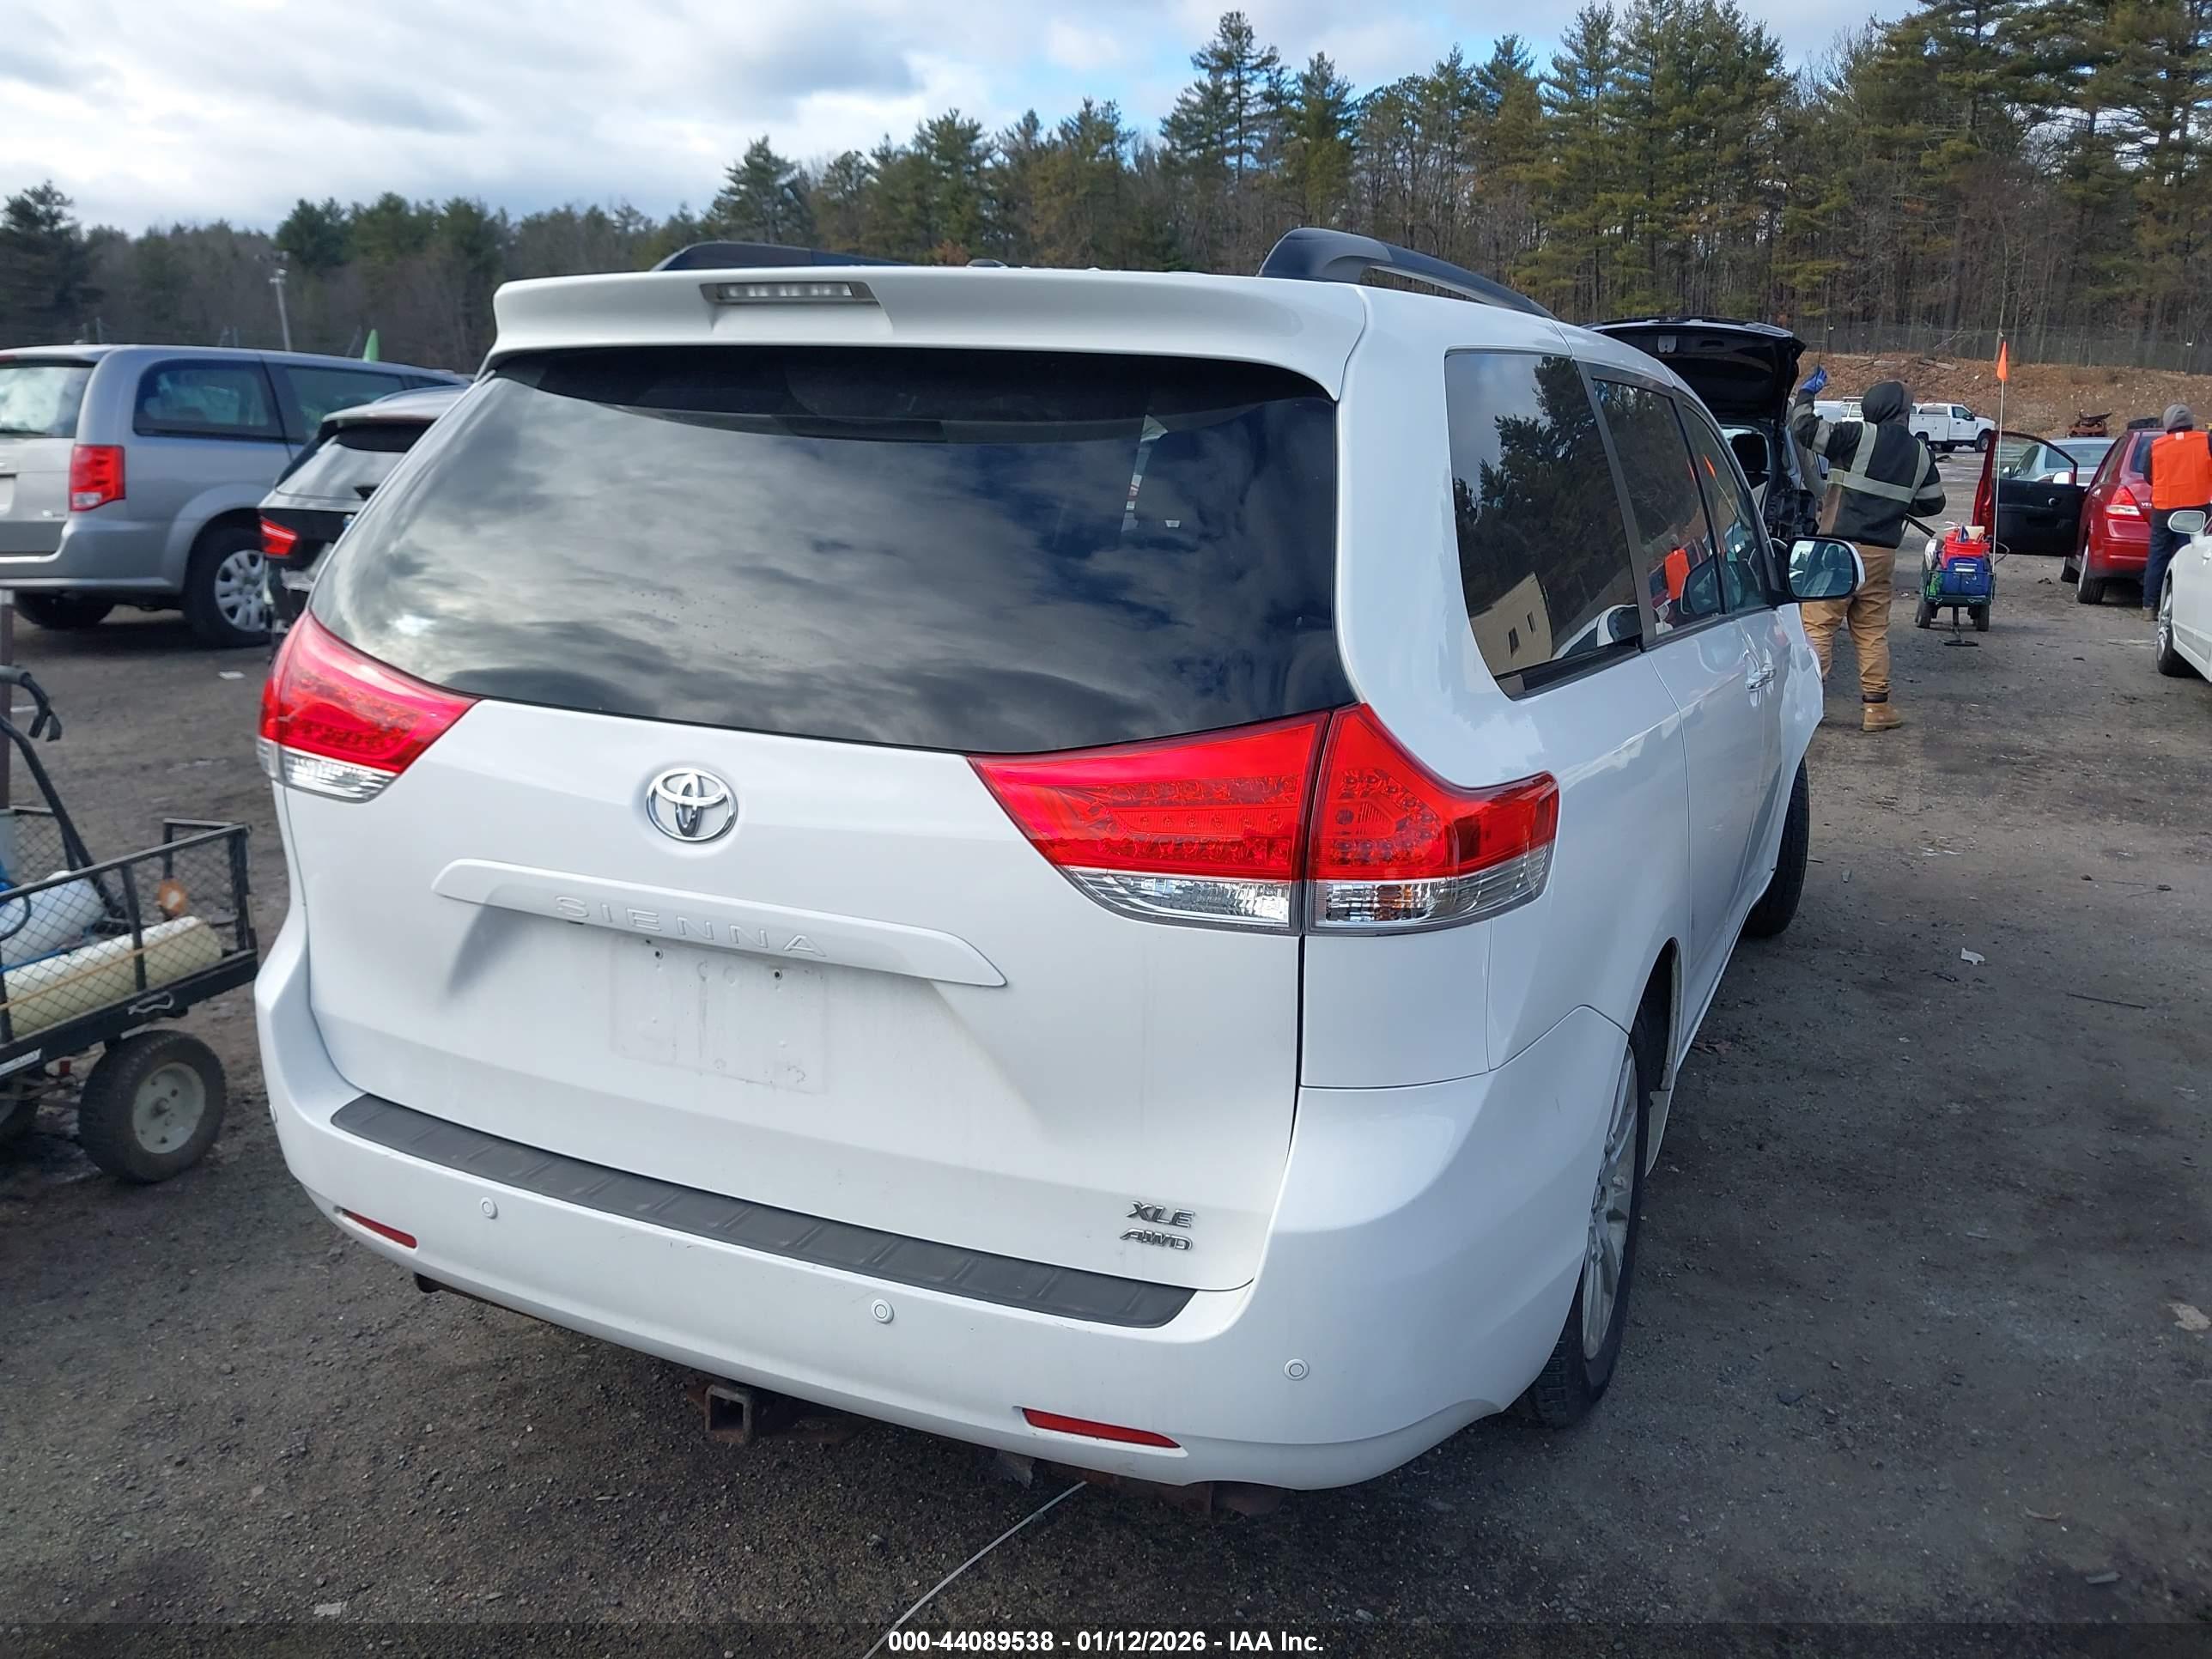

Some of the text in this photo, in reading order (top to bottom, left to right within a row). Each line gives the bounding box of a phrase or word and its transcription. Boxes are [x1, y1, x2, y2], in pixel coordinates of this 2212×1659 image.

[556, 896, 827, 957] SIENNA
[1126, 1200, 1195, 1228] XLE
[1120, 1228, 1193, 1250] AWD
